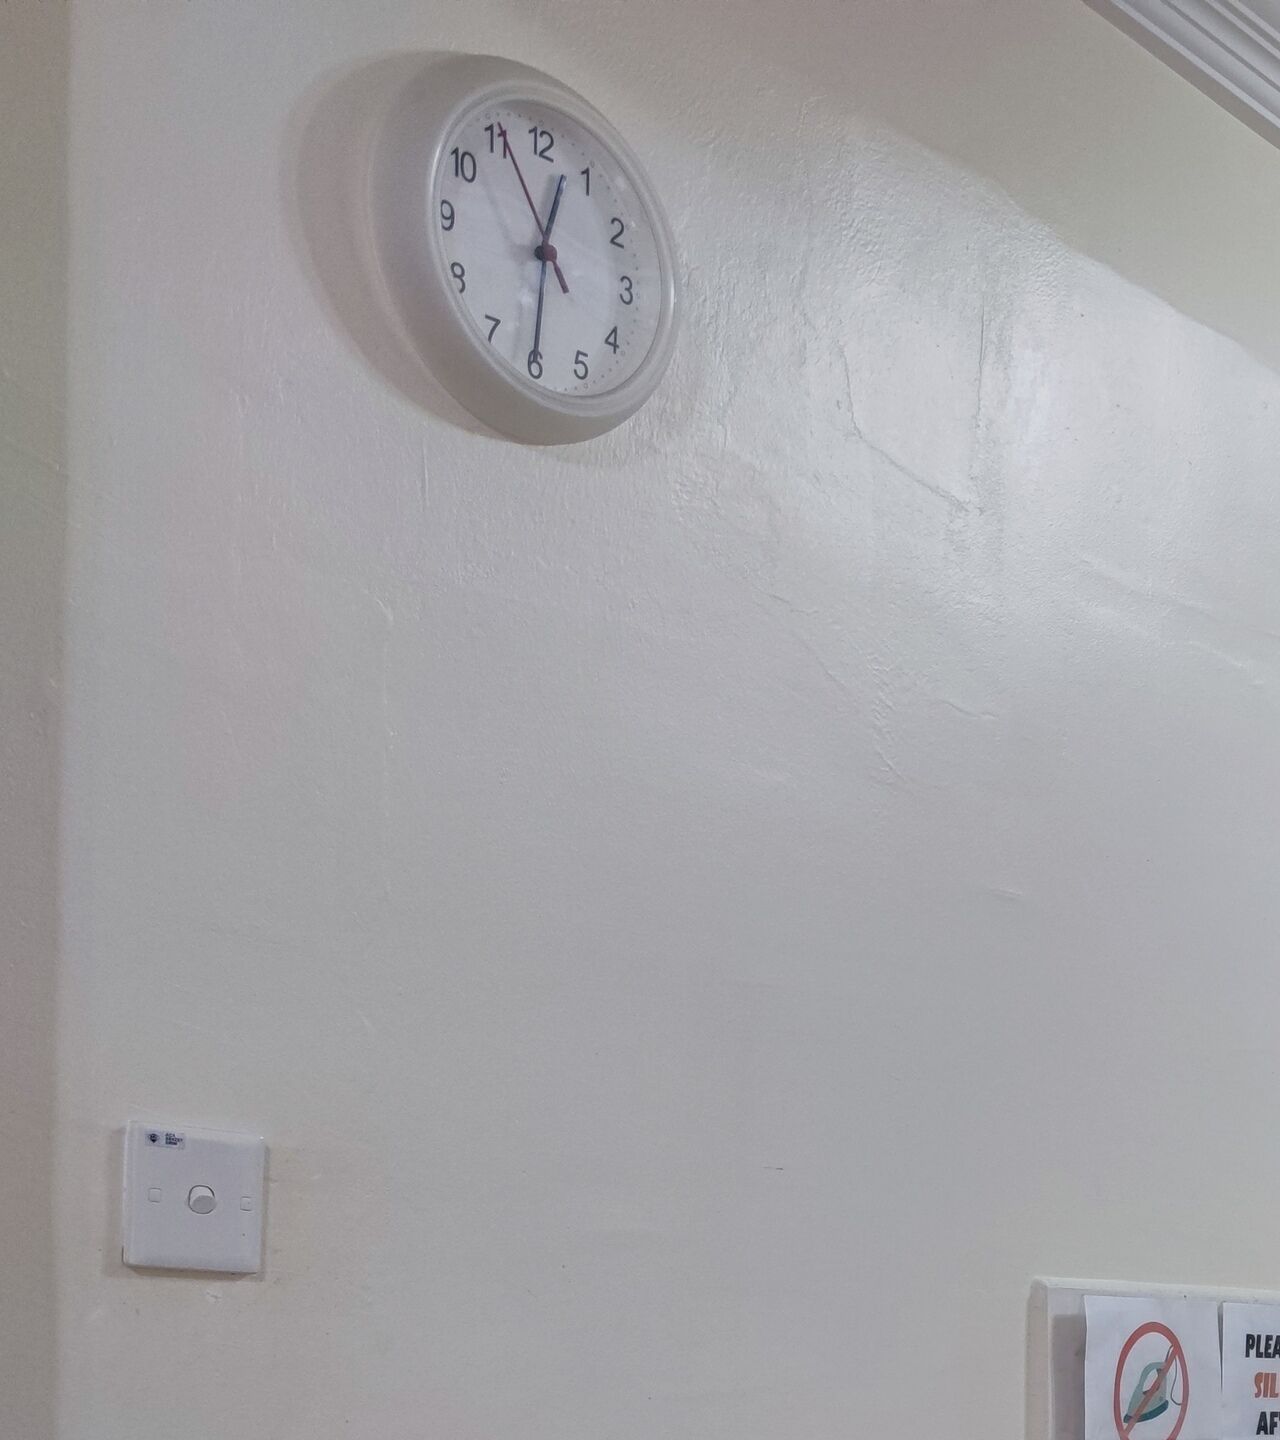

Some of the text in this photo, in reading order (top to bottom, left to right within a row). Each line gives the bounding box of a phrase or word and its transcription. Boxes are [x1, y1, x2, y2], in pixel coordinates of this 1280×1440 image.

[484, 123, 508, 159] 11
[528, 127, 554, 163] 12
[451, 147, 477, 183] 10
[580, 168, 591, 196] 1
[441, 200, 455, 231] 9
[610, 218, 625, 248] 2
[451, 262, 466, 293] 8
[619, 276, 633, 305] 3
[484, 314, 501, 342] 7
[604, 326, 619, 354] 4
[527, 350, 543, 379] 6
[574, 350, 589, 379] 5
